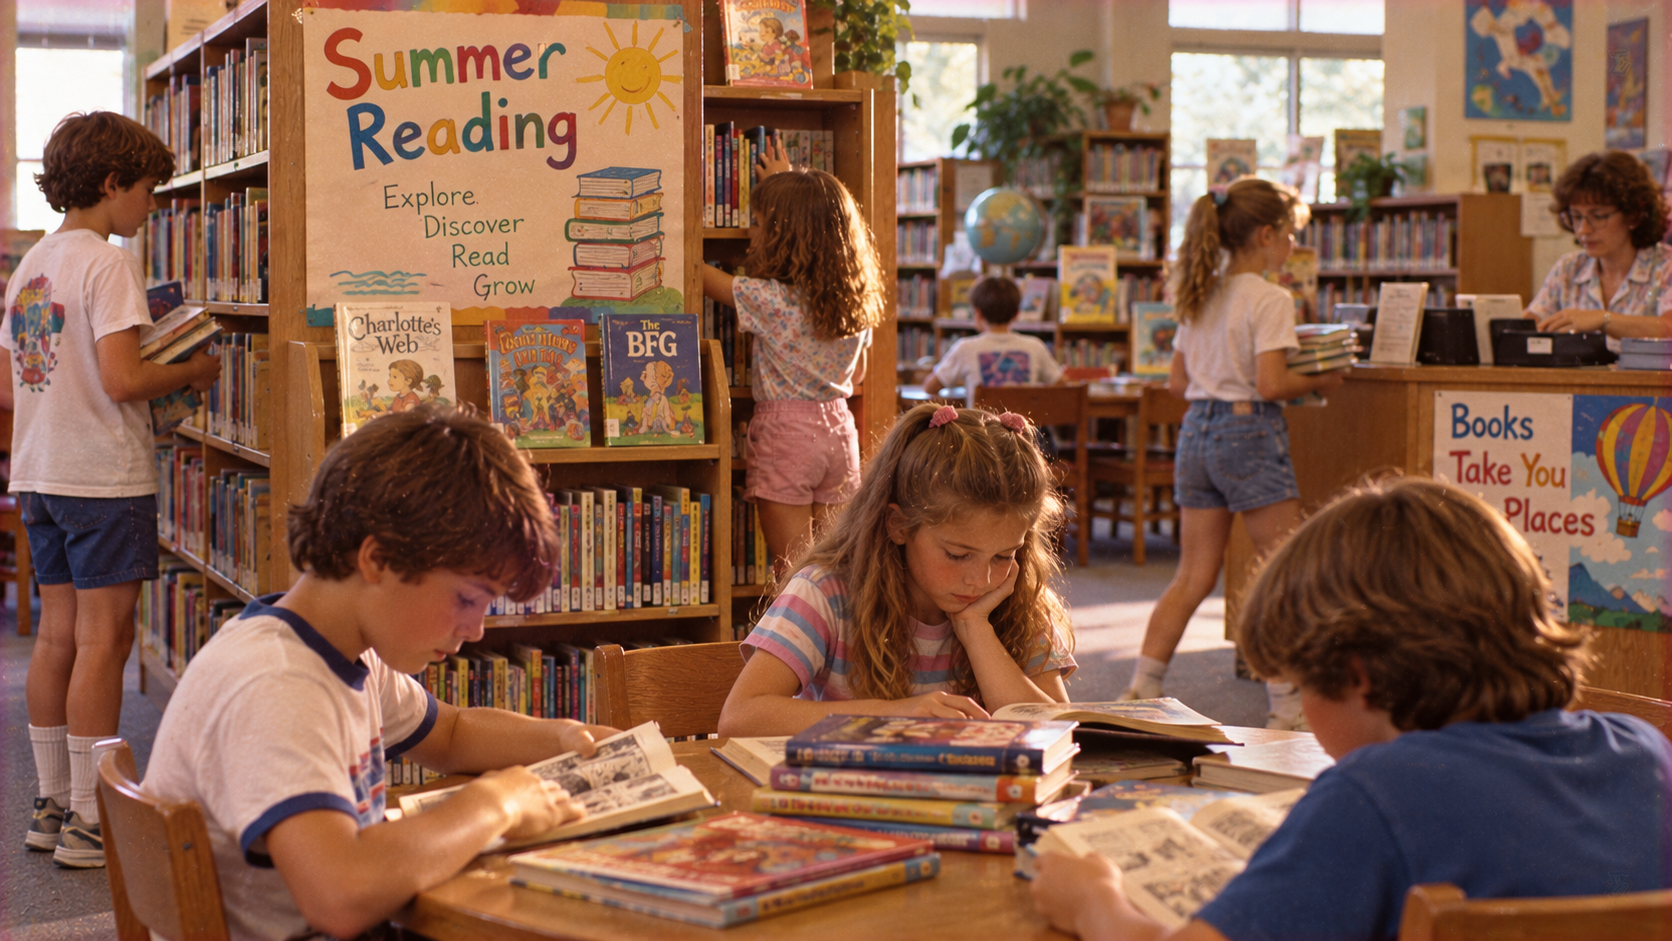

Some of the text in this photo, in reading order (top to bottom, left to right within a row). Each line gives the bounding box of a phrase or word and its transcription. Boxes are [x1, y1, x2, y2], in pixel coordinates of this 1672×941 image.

[324, 27, 567, 101] Summer
[346, 91, 577, 170] Reading
[424, 215, 525, 239] Discover
[452, 242, 510, 268] Read
[473, 273, 536, 301] Grow
[348, 311, 441, 341] Charlotte's
[640, 319, 660, 330] The
[375, 333, 419, 355] Web
[625, 330, 678, 357] BFG
[1451, 402, 1534, 440] Books
[1449, 450, 1566, 489] Take You
[1503, 496, 1595, 537] Places
